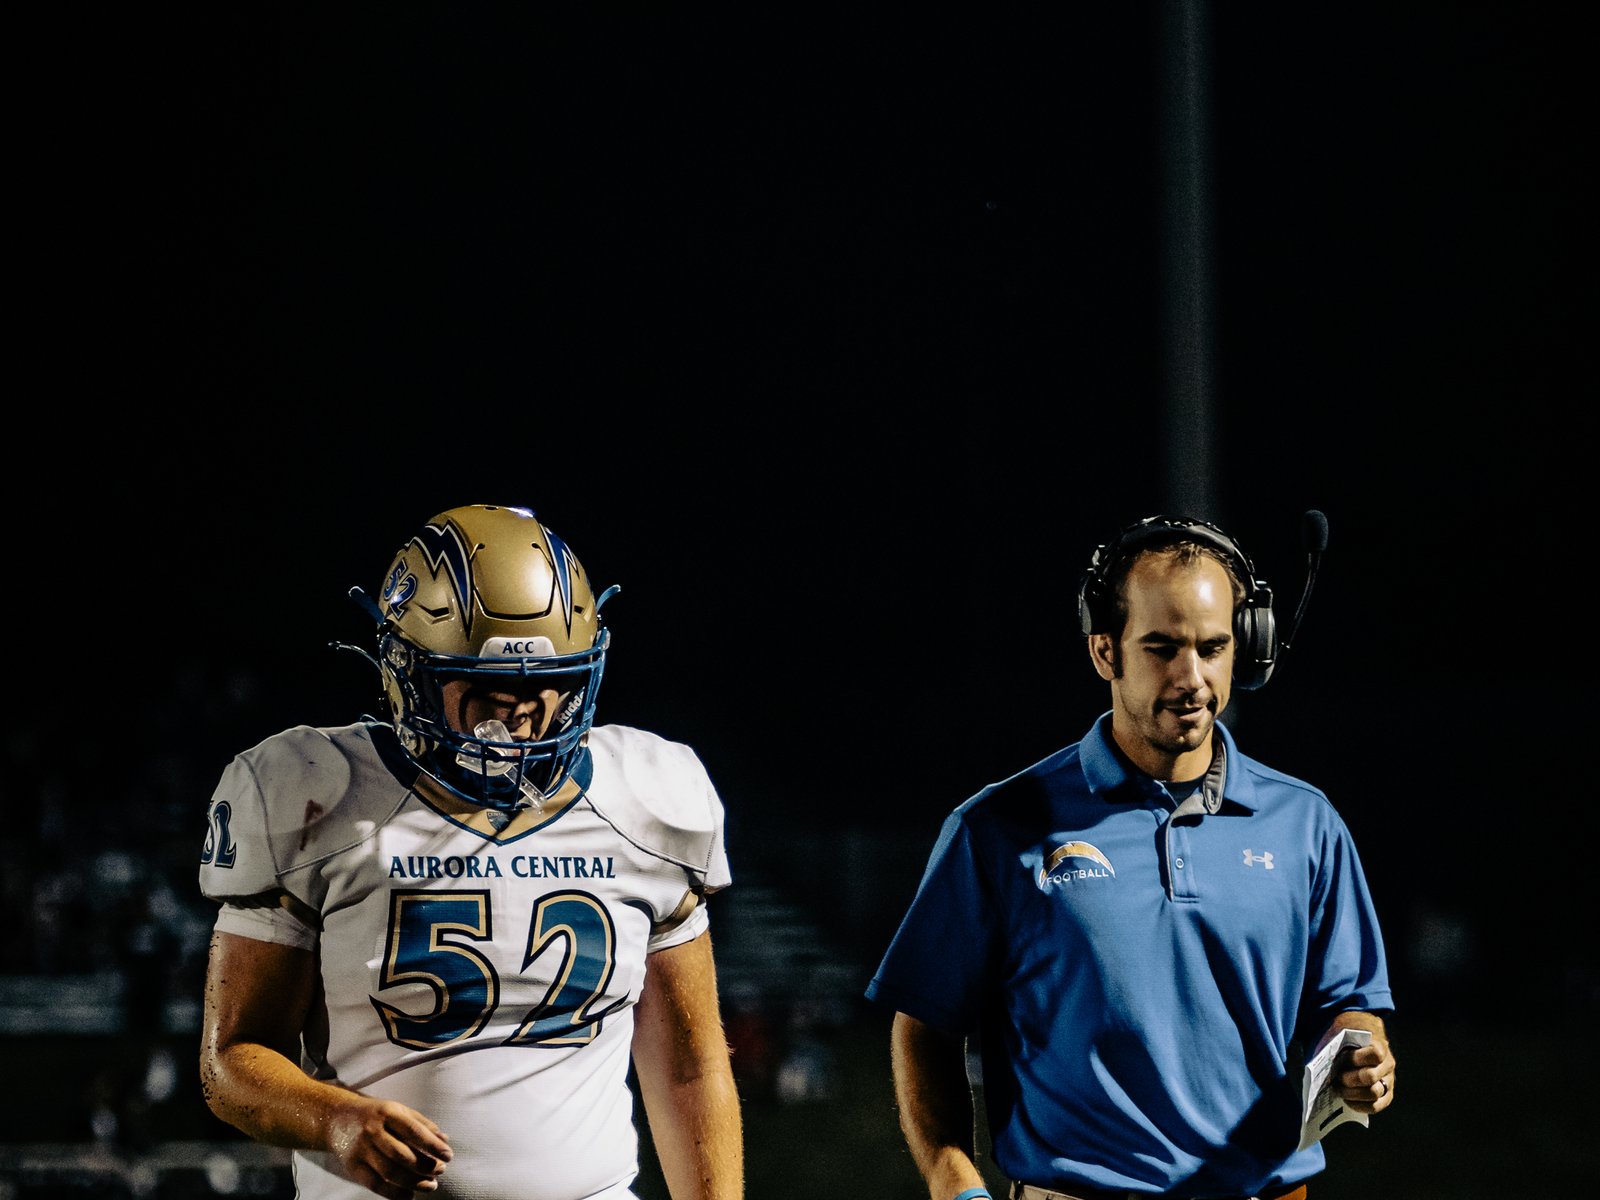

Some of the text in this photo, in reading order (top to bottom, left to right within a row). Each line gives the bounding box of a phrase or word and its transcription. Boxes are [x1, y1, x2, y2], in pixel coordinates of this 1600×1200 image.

[383, 557, 418, 620] 52
[502, 641, 534, 654] ACC
[388, 855, 616, 879] AURORA CENTRAL
[1046, 868, 1110, 887] FOOTBALL
[368, 888, 632, 1052] 52
